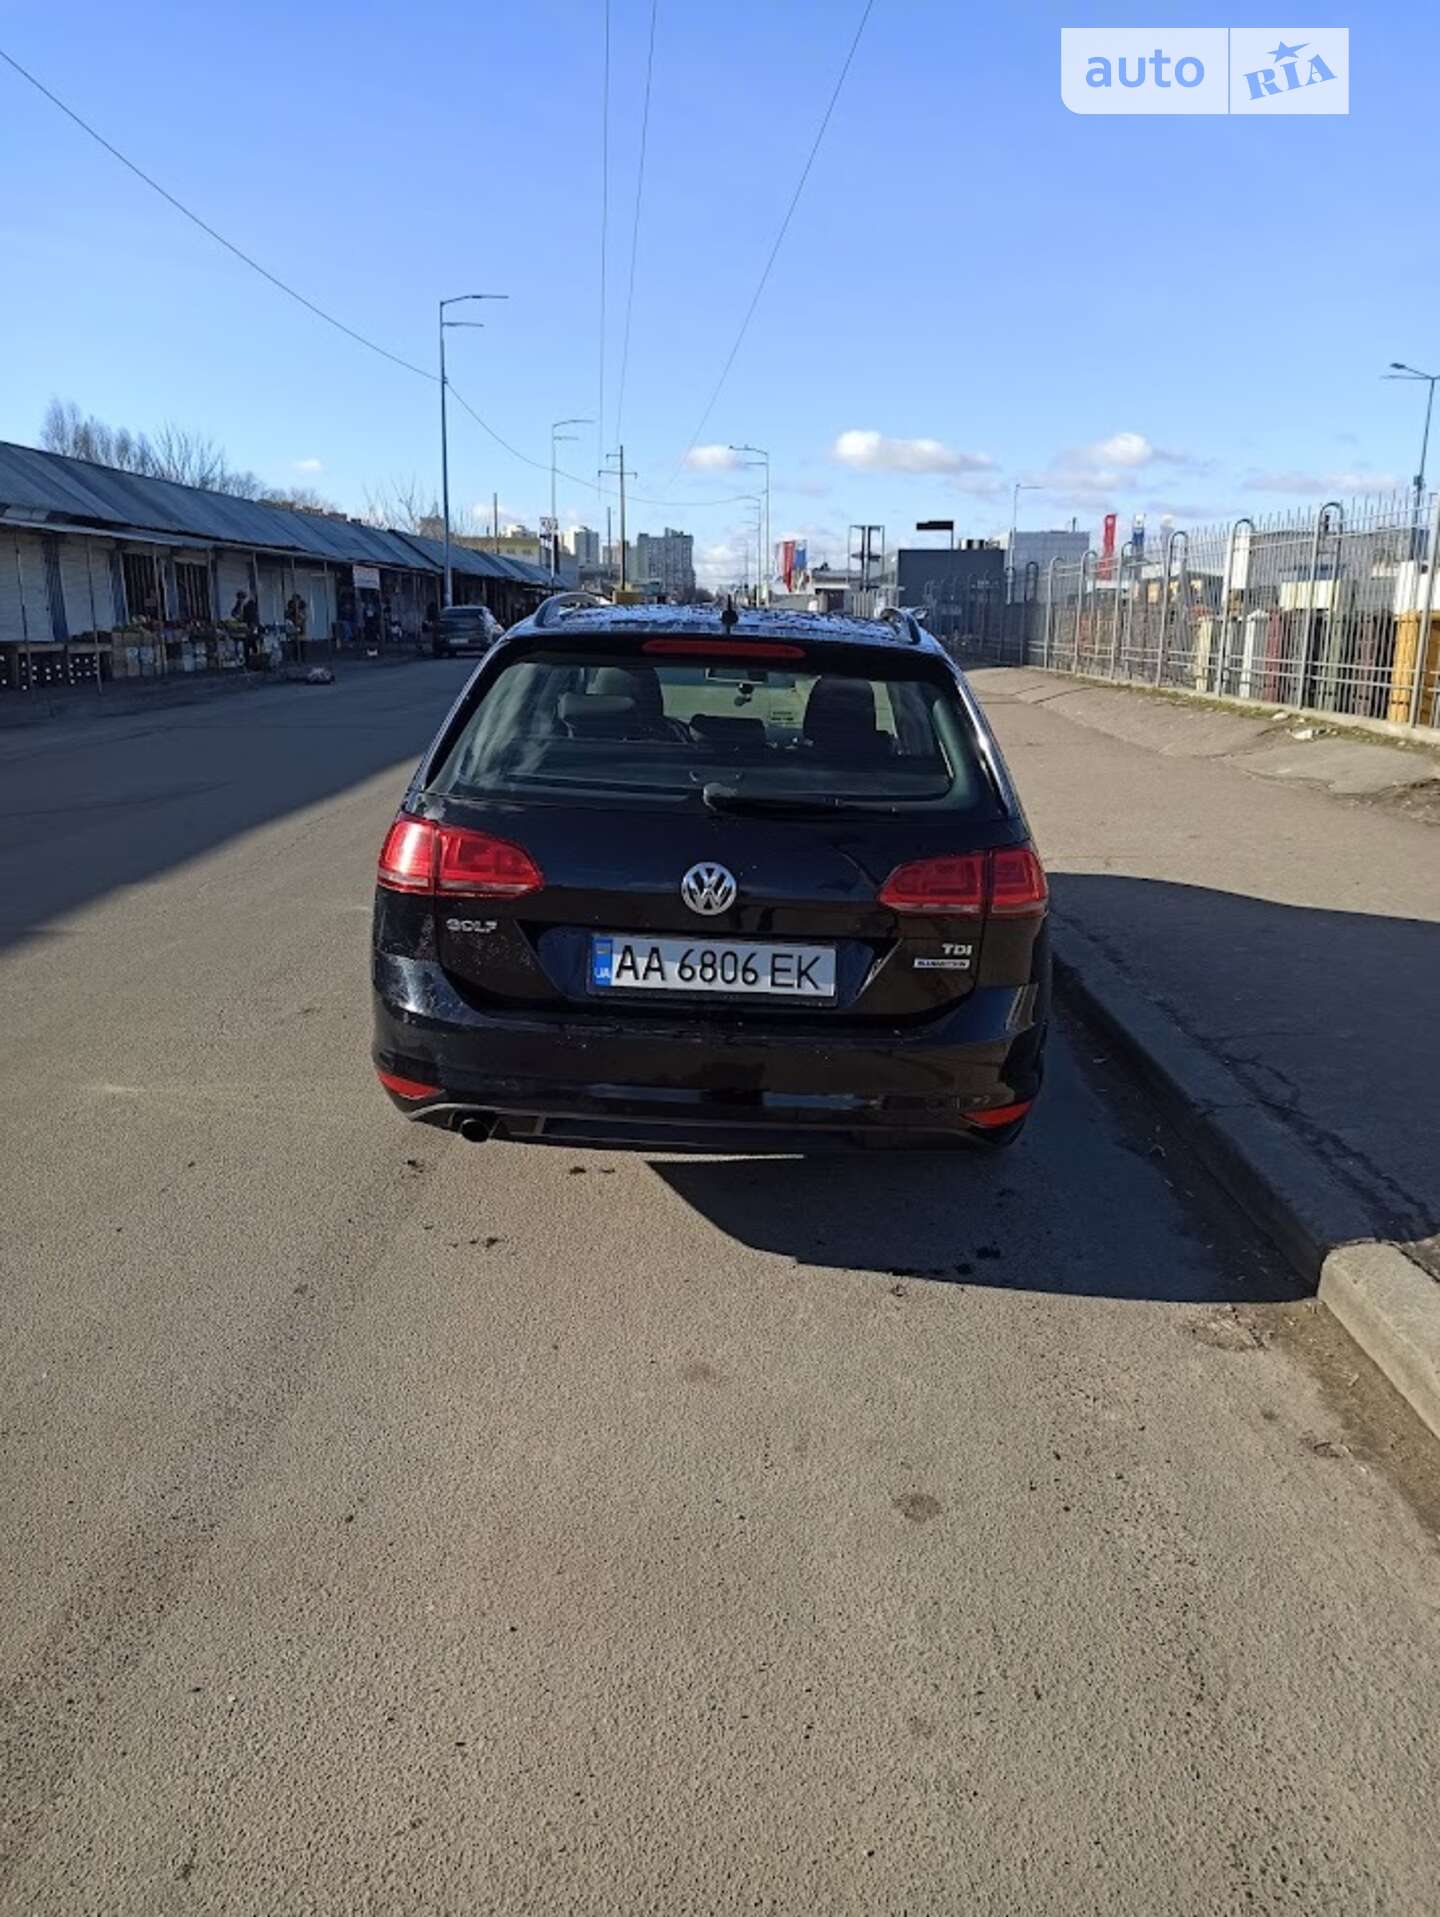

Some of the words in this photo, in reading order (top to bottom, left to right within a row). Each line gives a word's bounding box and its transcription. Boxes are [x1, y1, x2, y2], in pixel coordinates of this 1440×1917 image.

[941, 942, 973, 956] TDI
[615, 944, 667, 982] AA
[677, 949, 760, 986] 6806
[770, 953, 822, 991] EK
